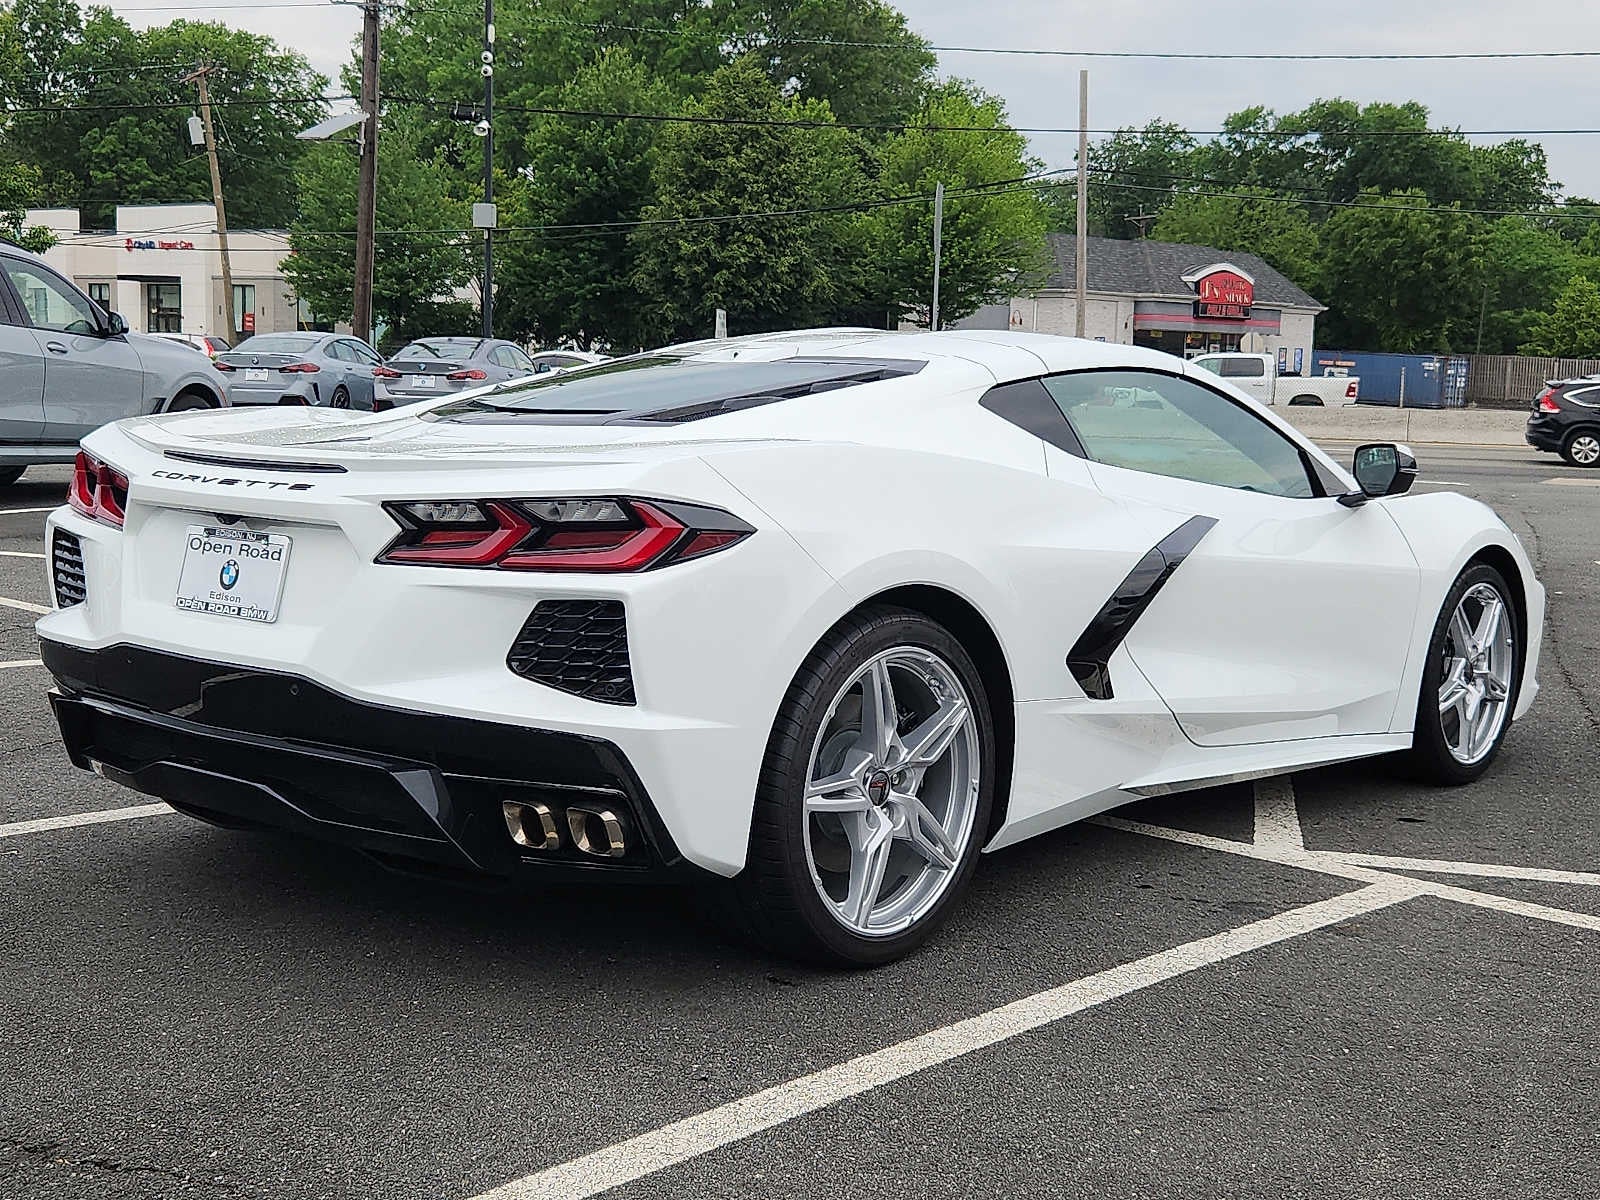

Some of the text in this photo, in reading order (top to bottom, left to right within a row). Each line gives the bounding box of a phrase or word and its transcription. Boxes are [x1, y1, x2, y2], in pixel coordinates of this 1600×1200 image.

[152, 470, 315, 490] CORVETTE
[190, 538, 282, 561] Open Road
[209, 591, 241, 603] Edison
[177, 598, 268, 620] OPEN ROAD BMW
